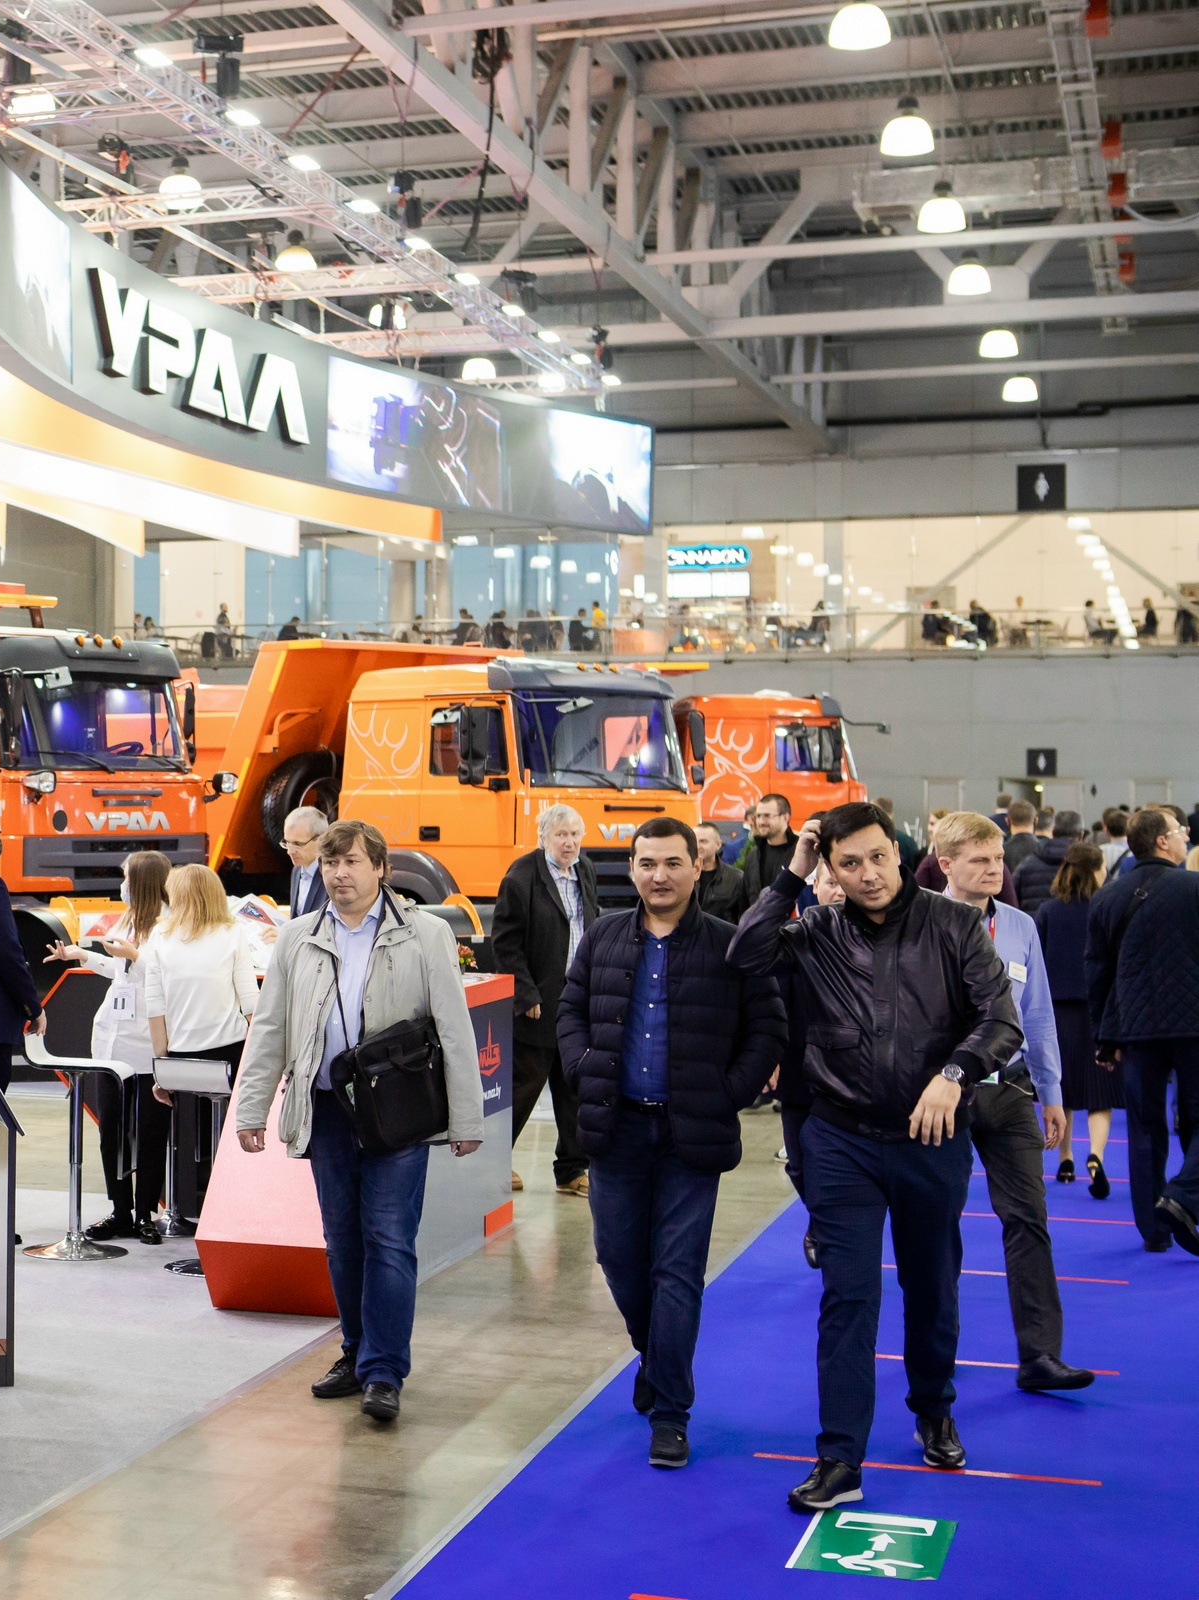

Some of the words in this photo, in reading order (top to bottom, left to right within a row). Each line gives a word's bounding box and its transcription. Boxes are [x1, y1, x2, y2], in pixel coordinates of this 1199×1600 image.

[90, 267, 311, 446] УРАЛ
[85, 811, 171, 831] УРАЛ
[598, 823, 642, 841] УР
